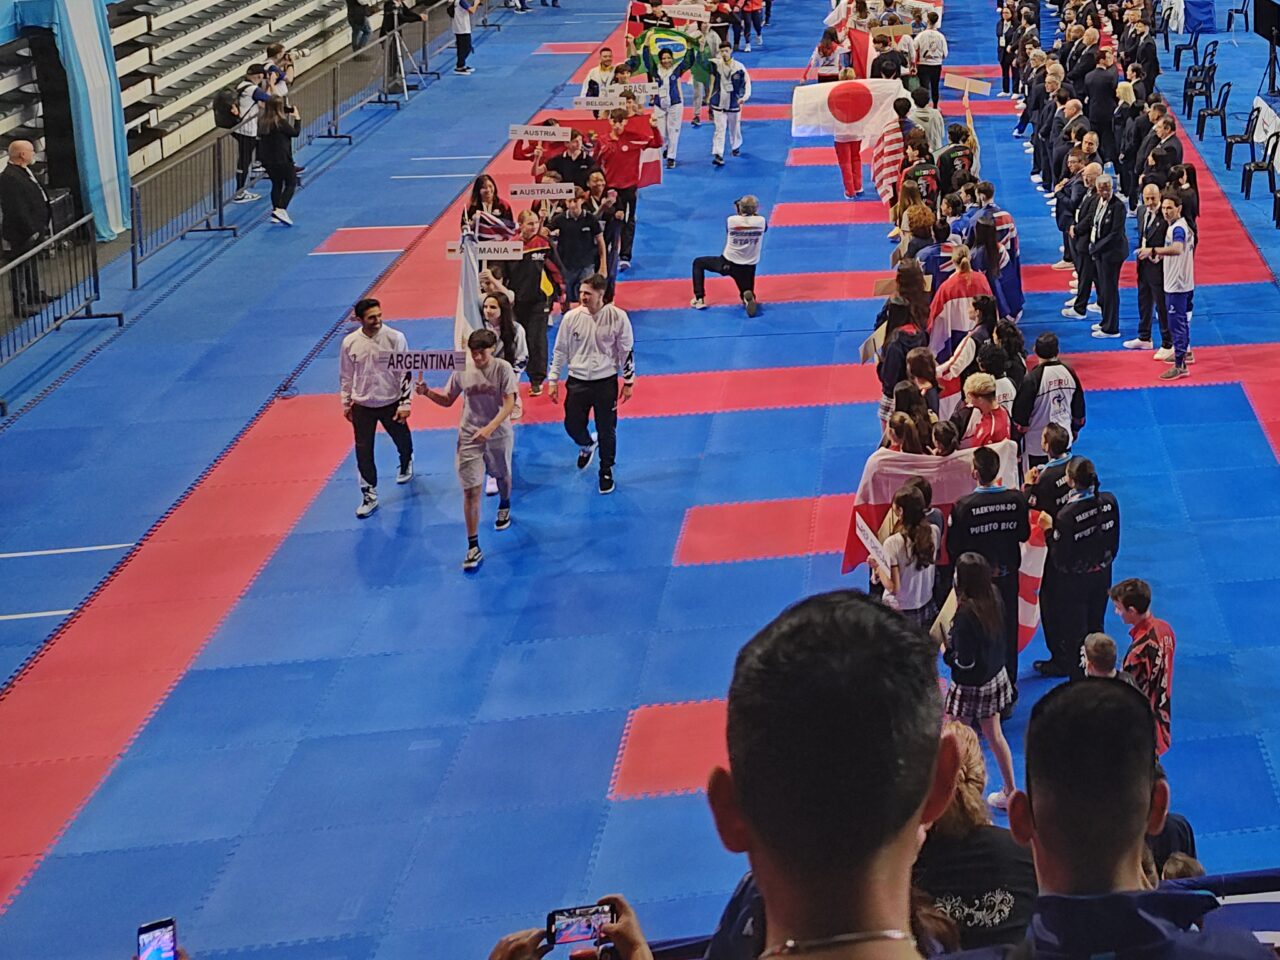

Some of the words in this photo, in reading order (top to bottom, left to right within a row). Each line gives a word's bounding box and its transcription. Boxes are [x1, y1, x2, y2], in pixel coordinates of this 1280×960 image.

[523, 129, 557, 137] AUSTRIA
[519, 187, 565, 196] AUSTRALIA
[387, 353, 456, 370] ARGENTINA
[971, 503, 1017, 516] TAEKWON-DO
[970, 522, 999, 534] PUERTO
